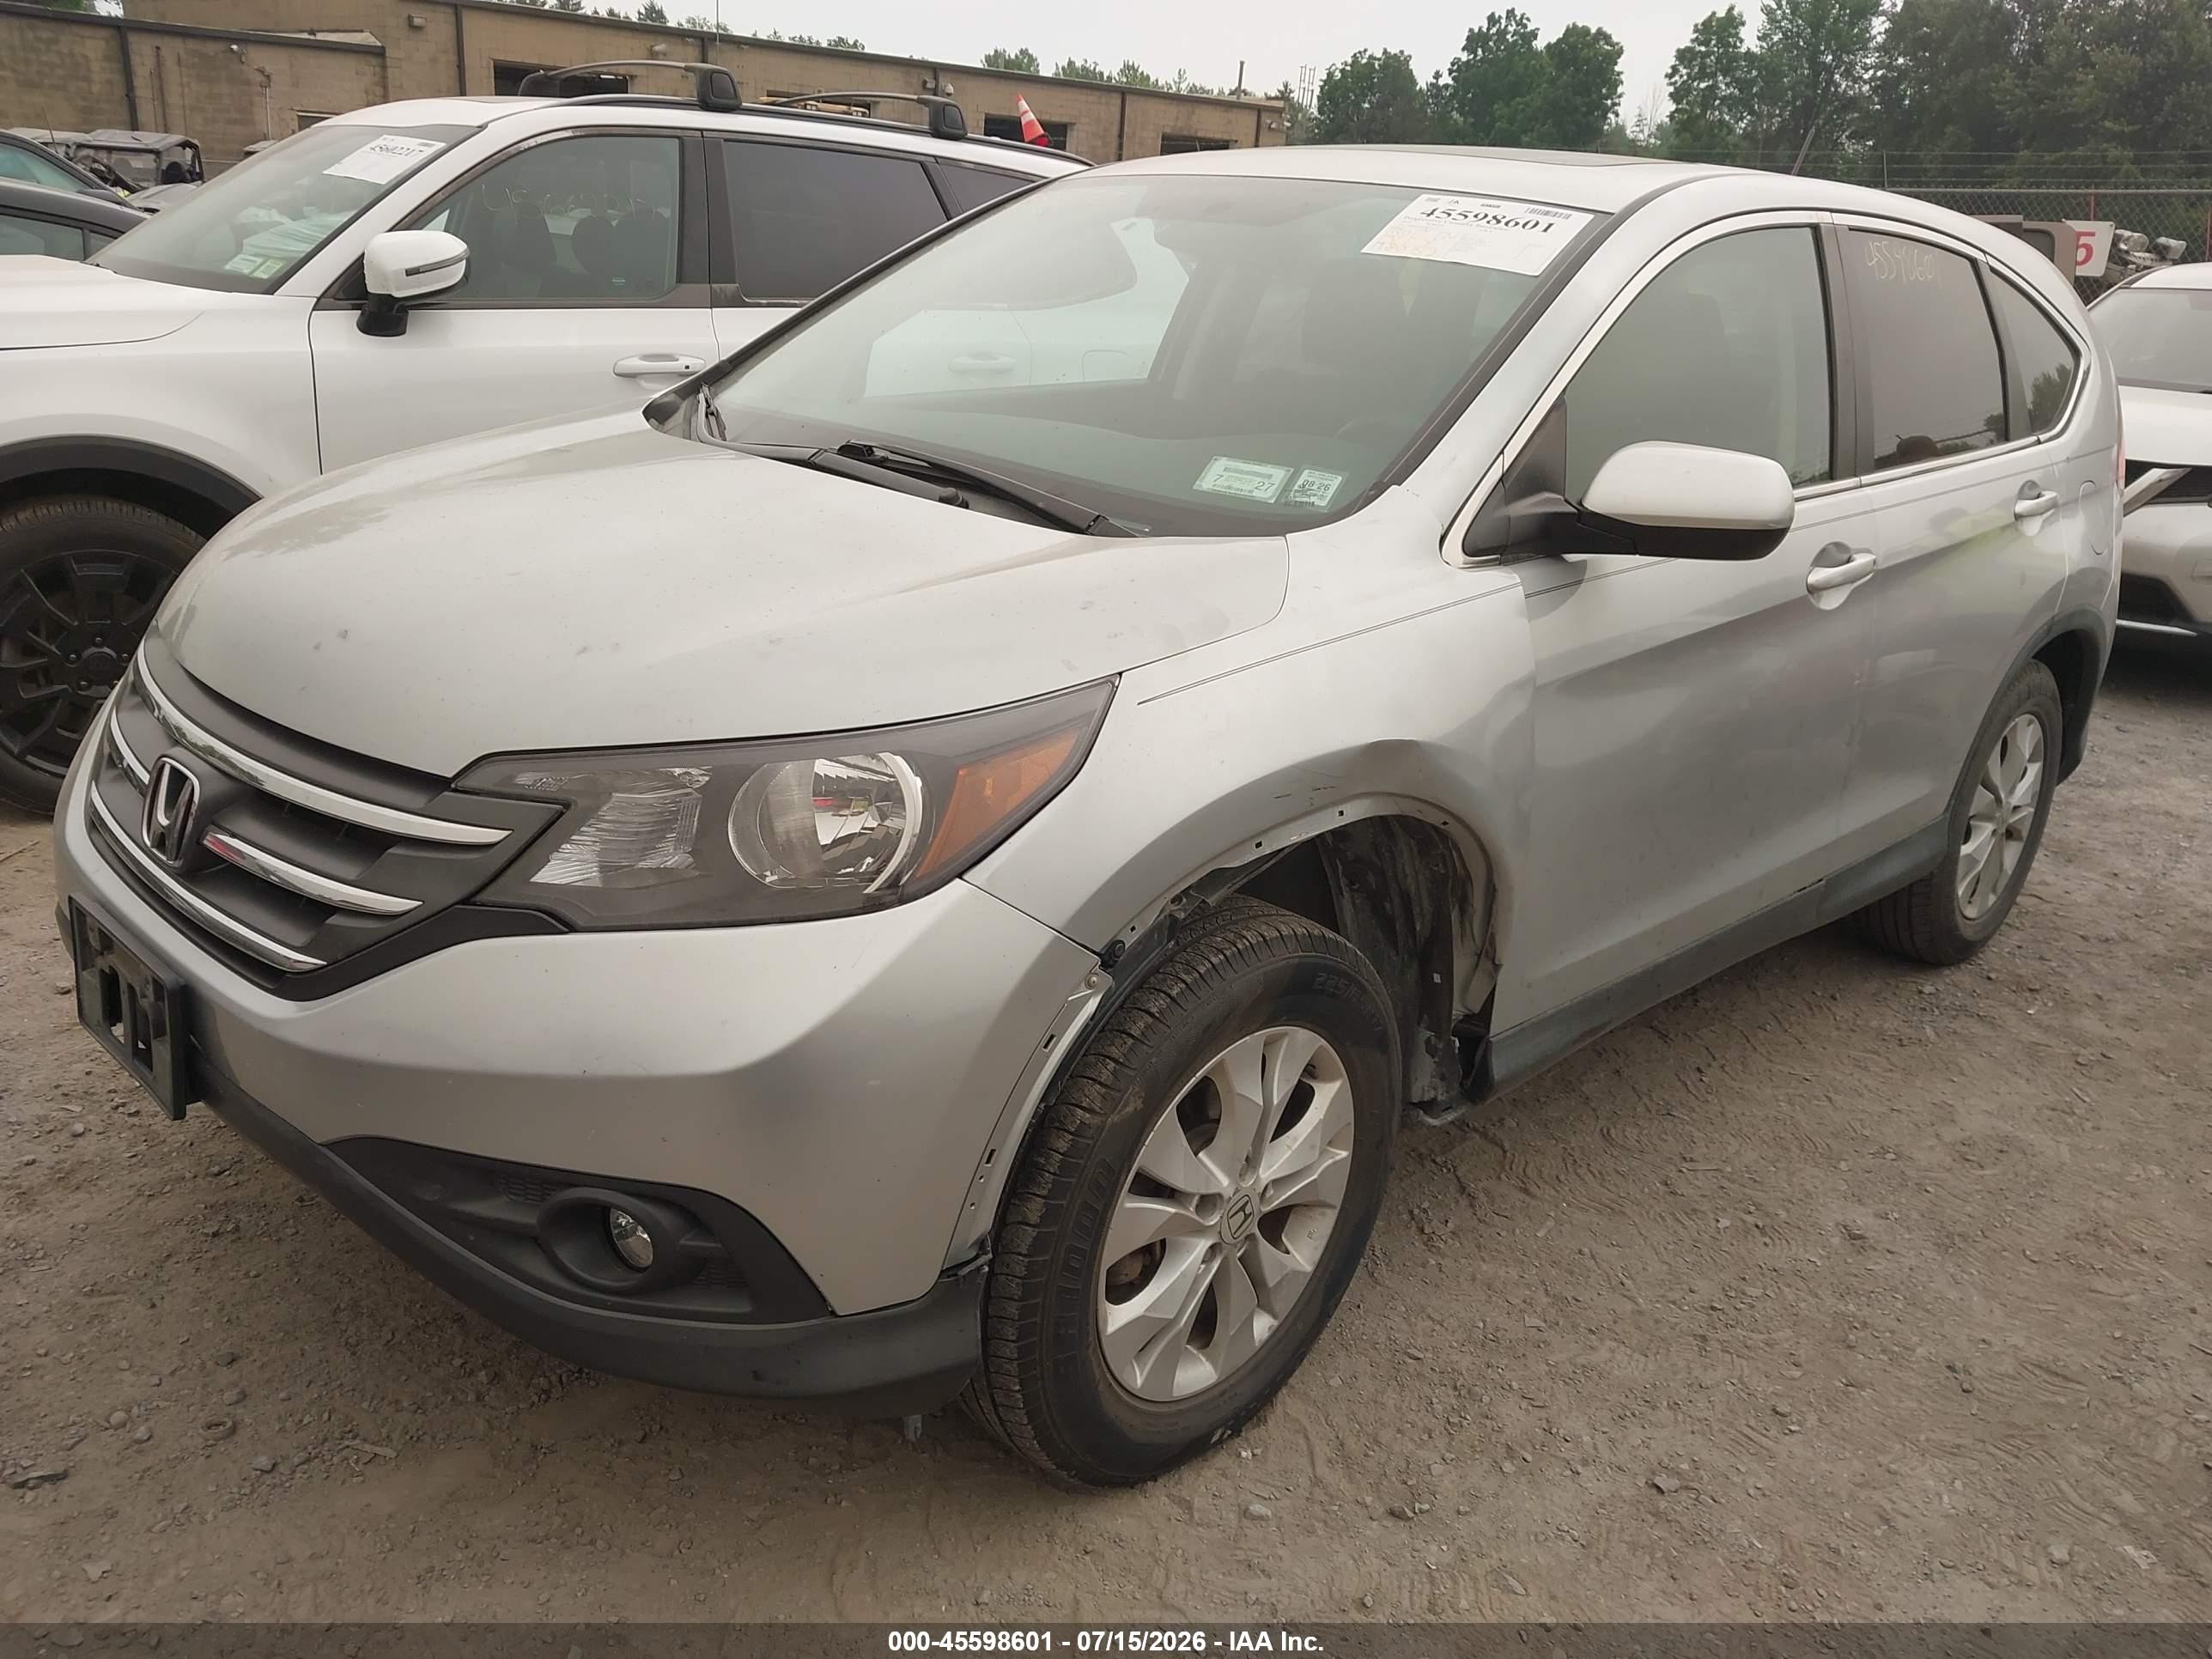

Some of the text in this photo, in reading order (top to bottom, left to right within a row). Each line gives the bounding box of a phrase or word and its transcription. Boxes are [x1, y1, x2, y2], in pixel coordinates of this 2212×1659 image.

[1419, 207, 1555, 233] 45598601
[2075, 231, 2096, 266] 5
[1255, 481, 1276, 492] 27
